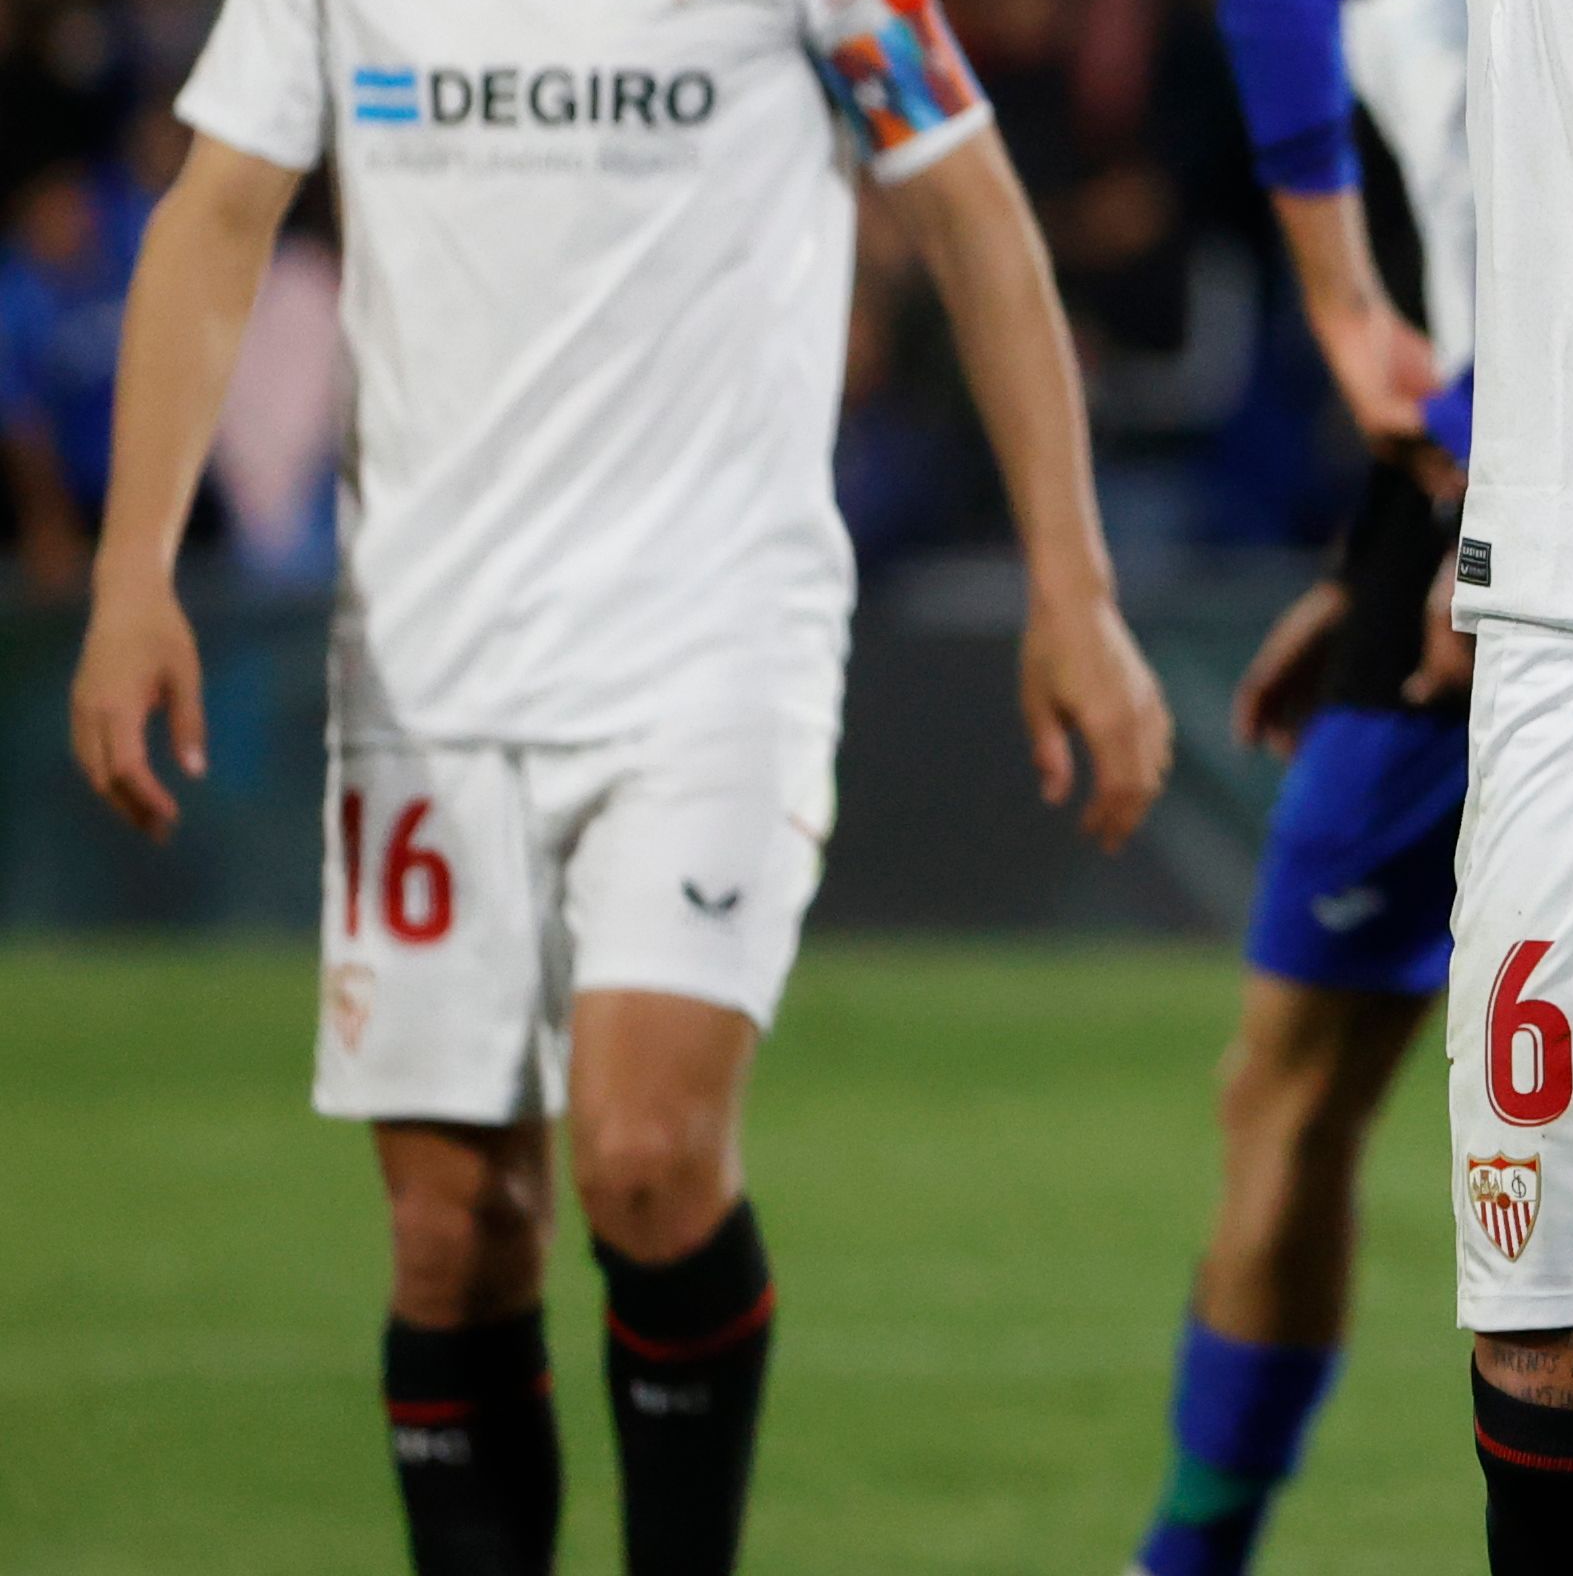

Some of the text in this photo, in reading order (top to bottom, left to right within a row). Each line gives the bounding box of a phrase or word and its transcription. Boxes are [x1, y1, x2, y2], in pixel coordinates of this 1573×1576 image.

[430, 65, 717, 126] DEGIRO
[340, 787, 454, 947] 16
[1485, 939, 1573, 1128] 6
